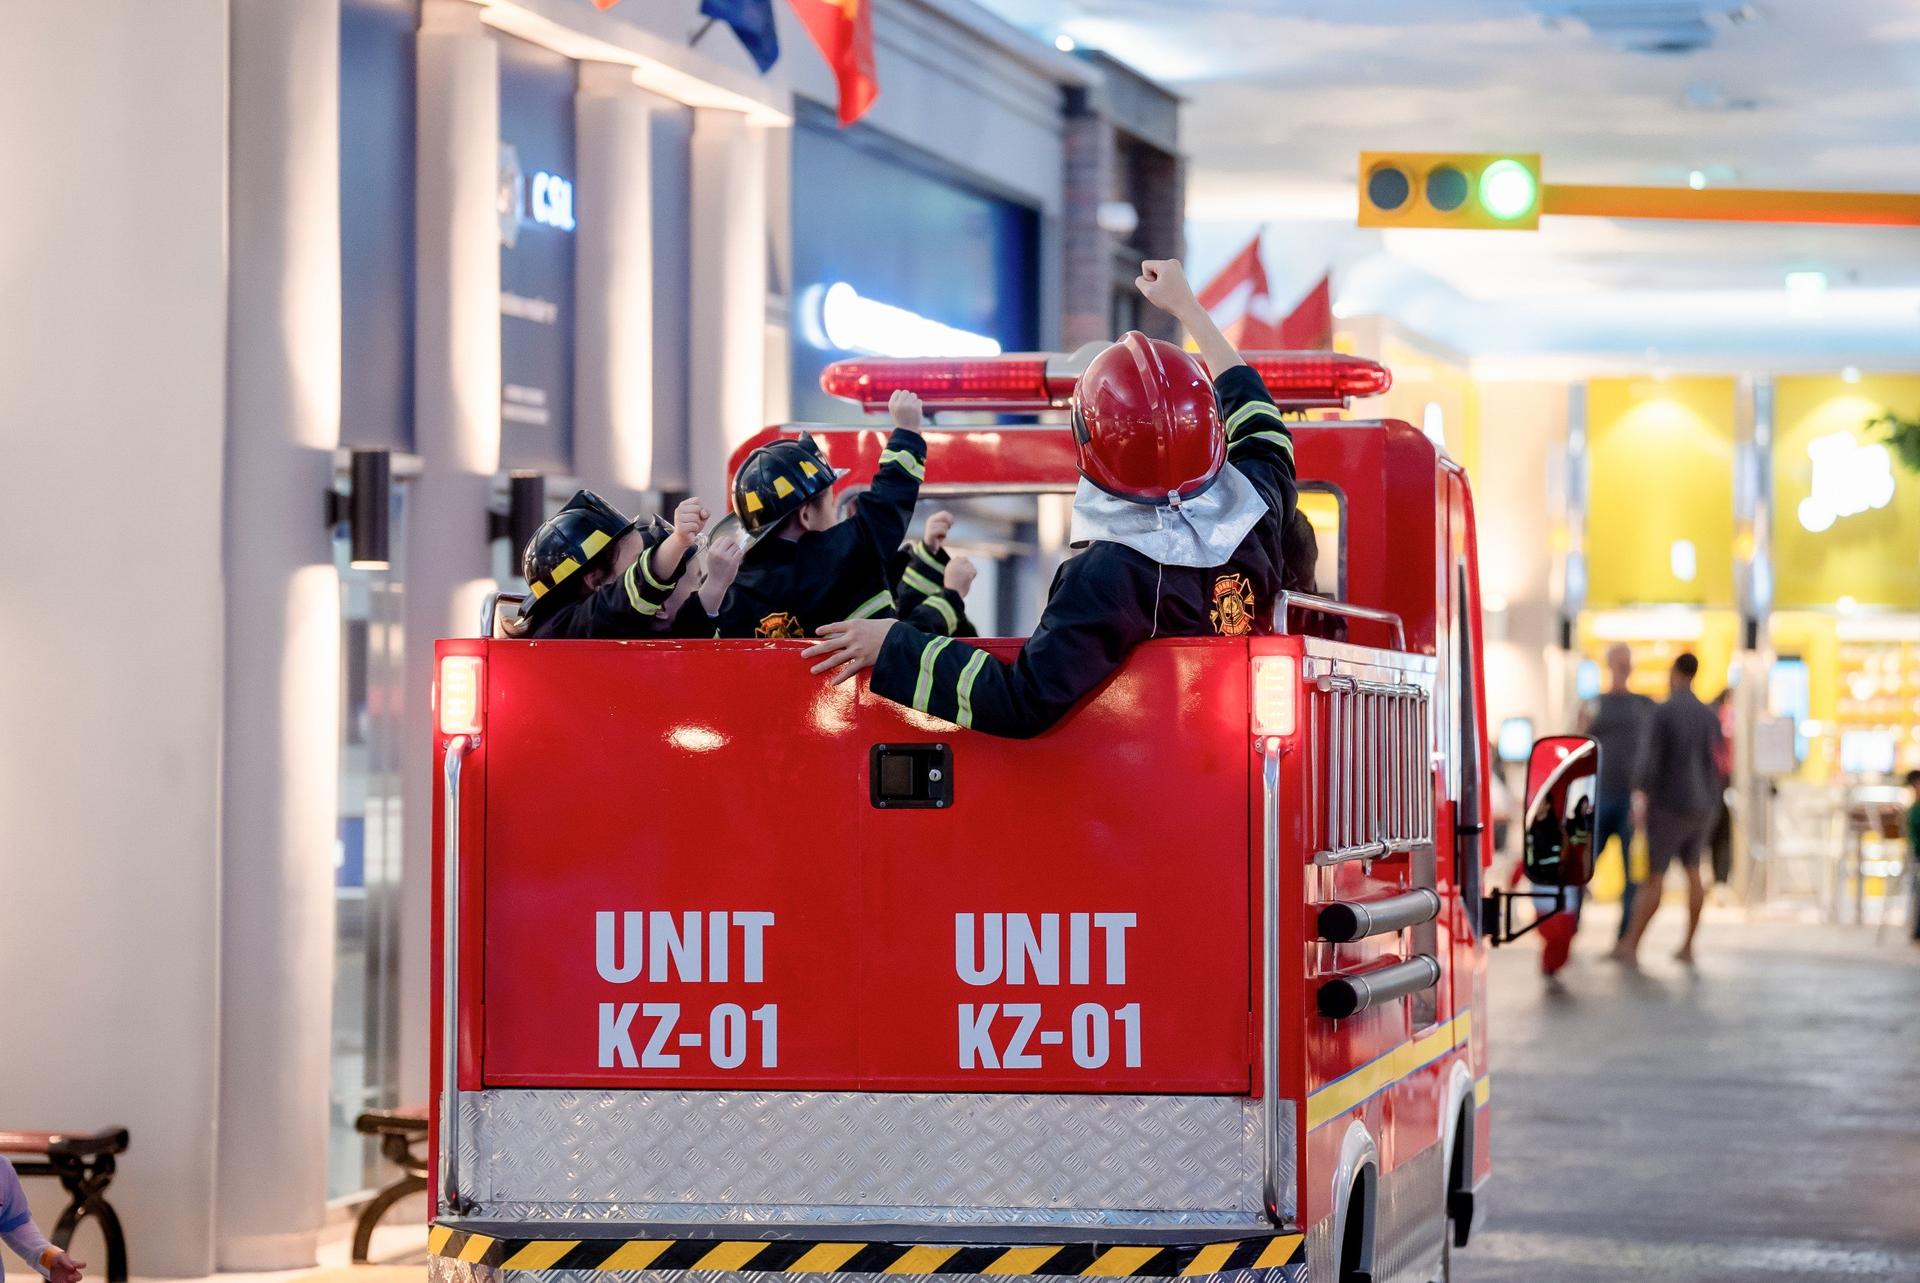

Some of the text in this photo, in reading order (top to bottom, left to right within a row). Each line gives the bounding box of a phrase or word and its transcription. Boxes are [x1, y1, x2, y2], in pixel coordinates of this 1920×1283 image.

[595, 911, 776, 984] UNIT
[955, 912, 1138, 986] UNIT
[598, 1002, 779, 1070] KZ-01
[957, 1002, 1142, 1070] KZ-01
